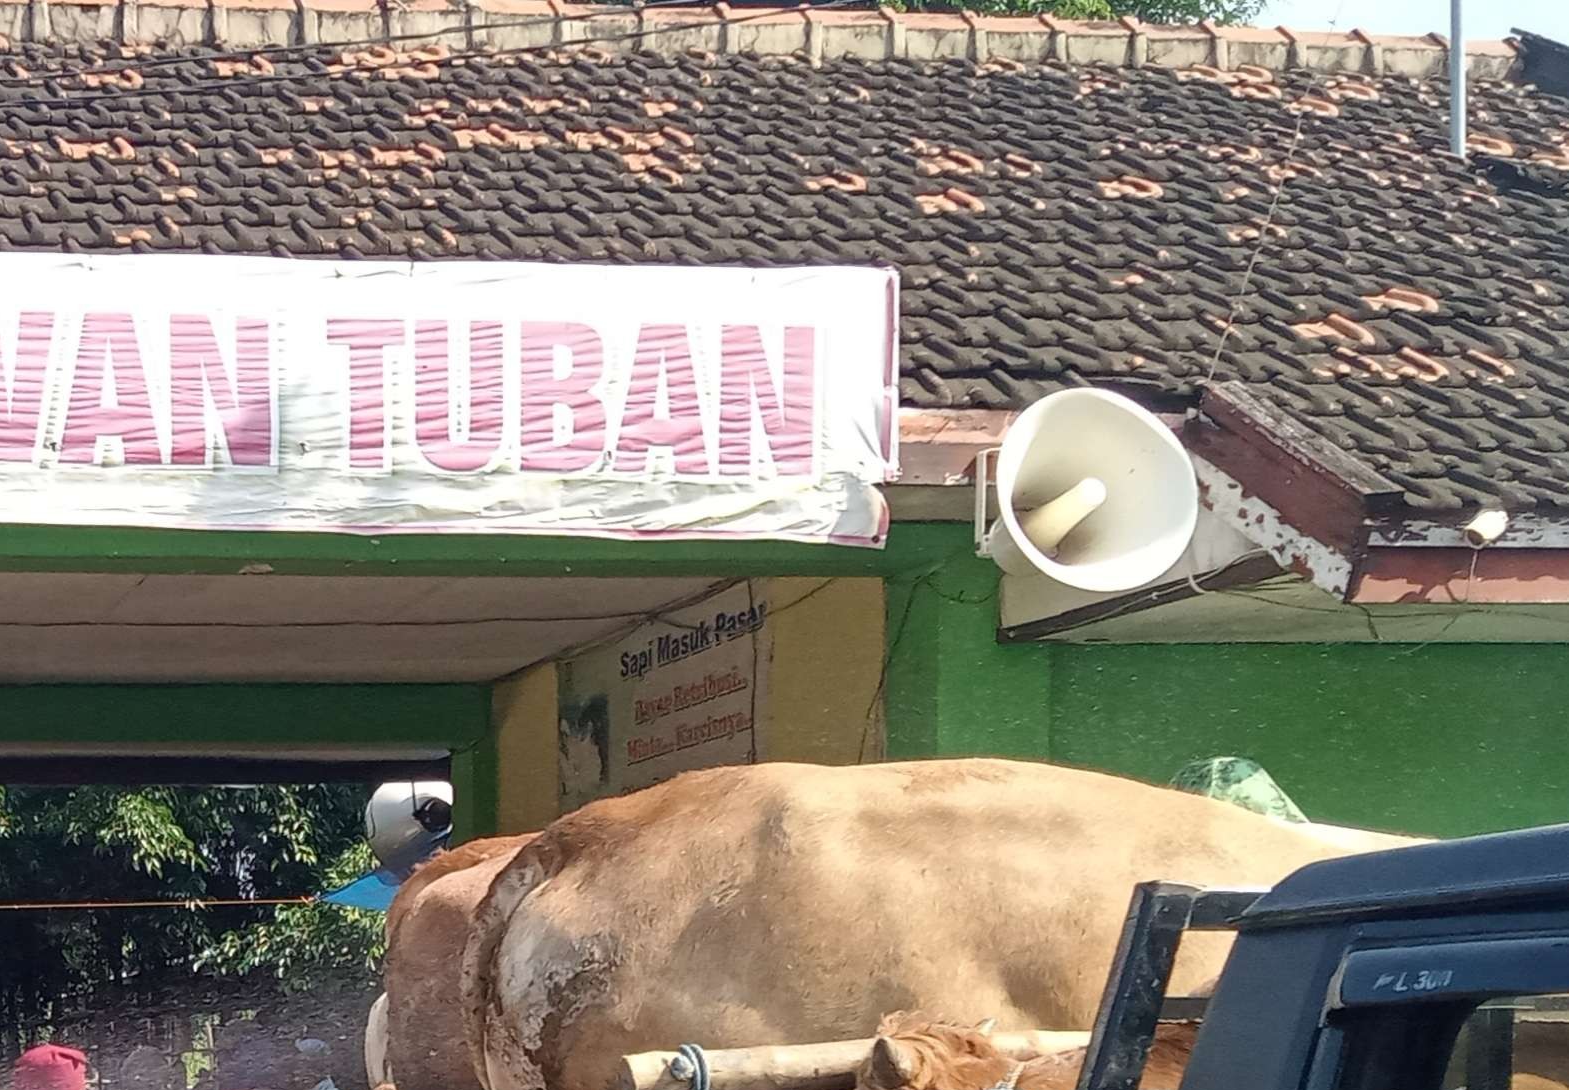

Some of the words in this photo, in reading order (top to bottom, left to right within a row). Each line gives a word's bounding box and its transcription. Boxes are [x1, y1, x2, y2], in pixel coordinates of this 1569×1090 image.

[326, 318, 816, 477] TUBAN
[620, 640, 653, 679] Sapi
[657, 621, 712, 664] Masuk
[714, 601, 768, 643] Pasar
